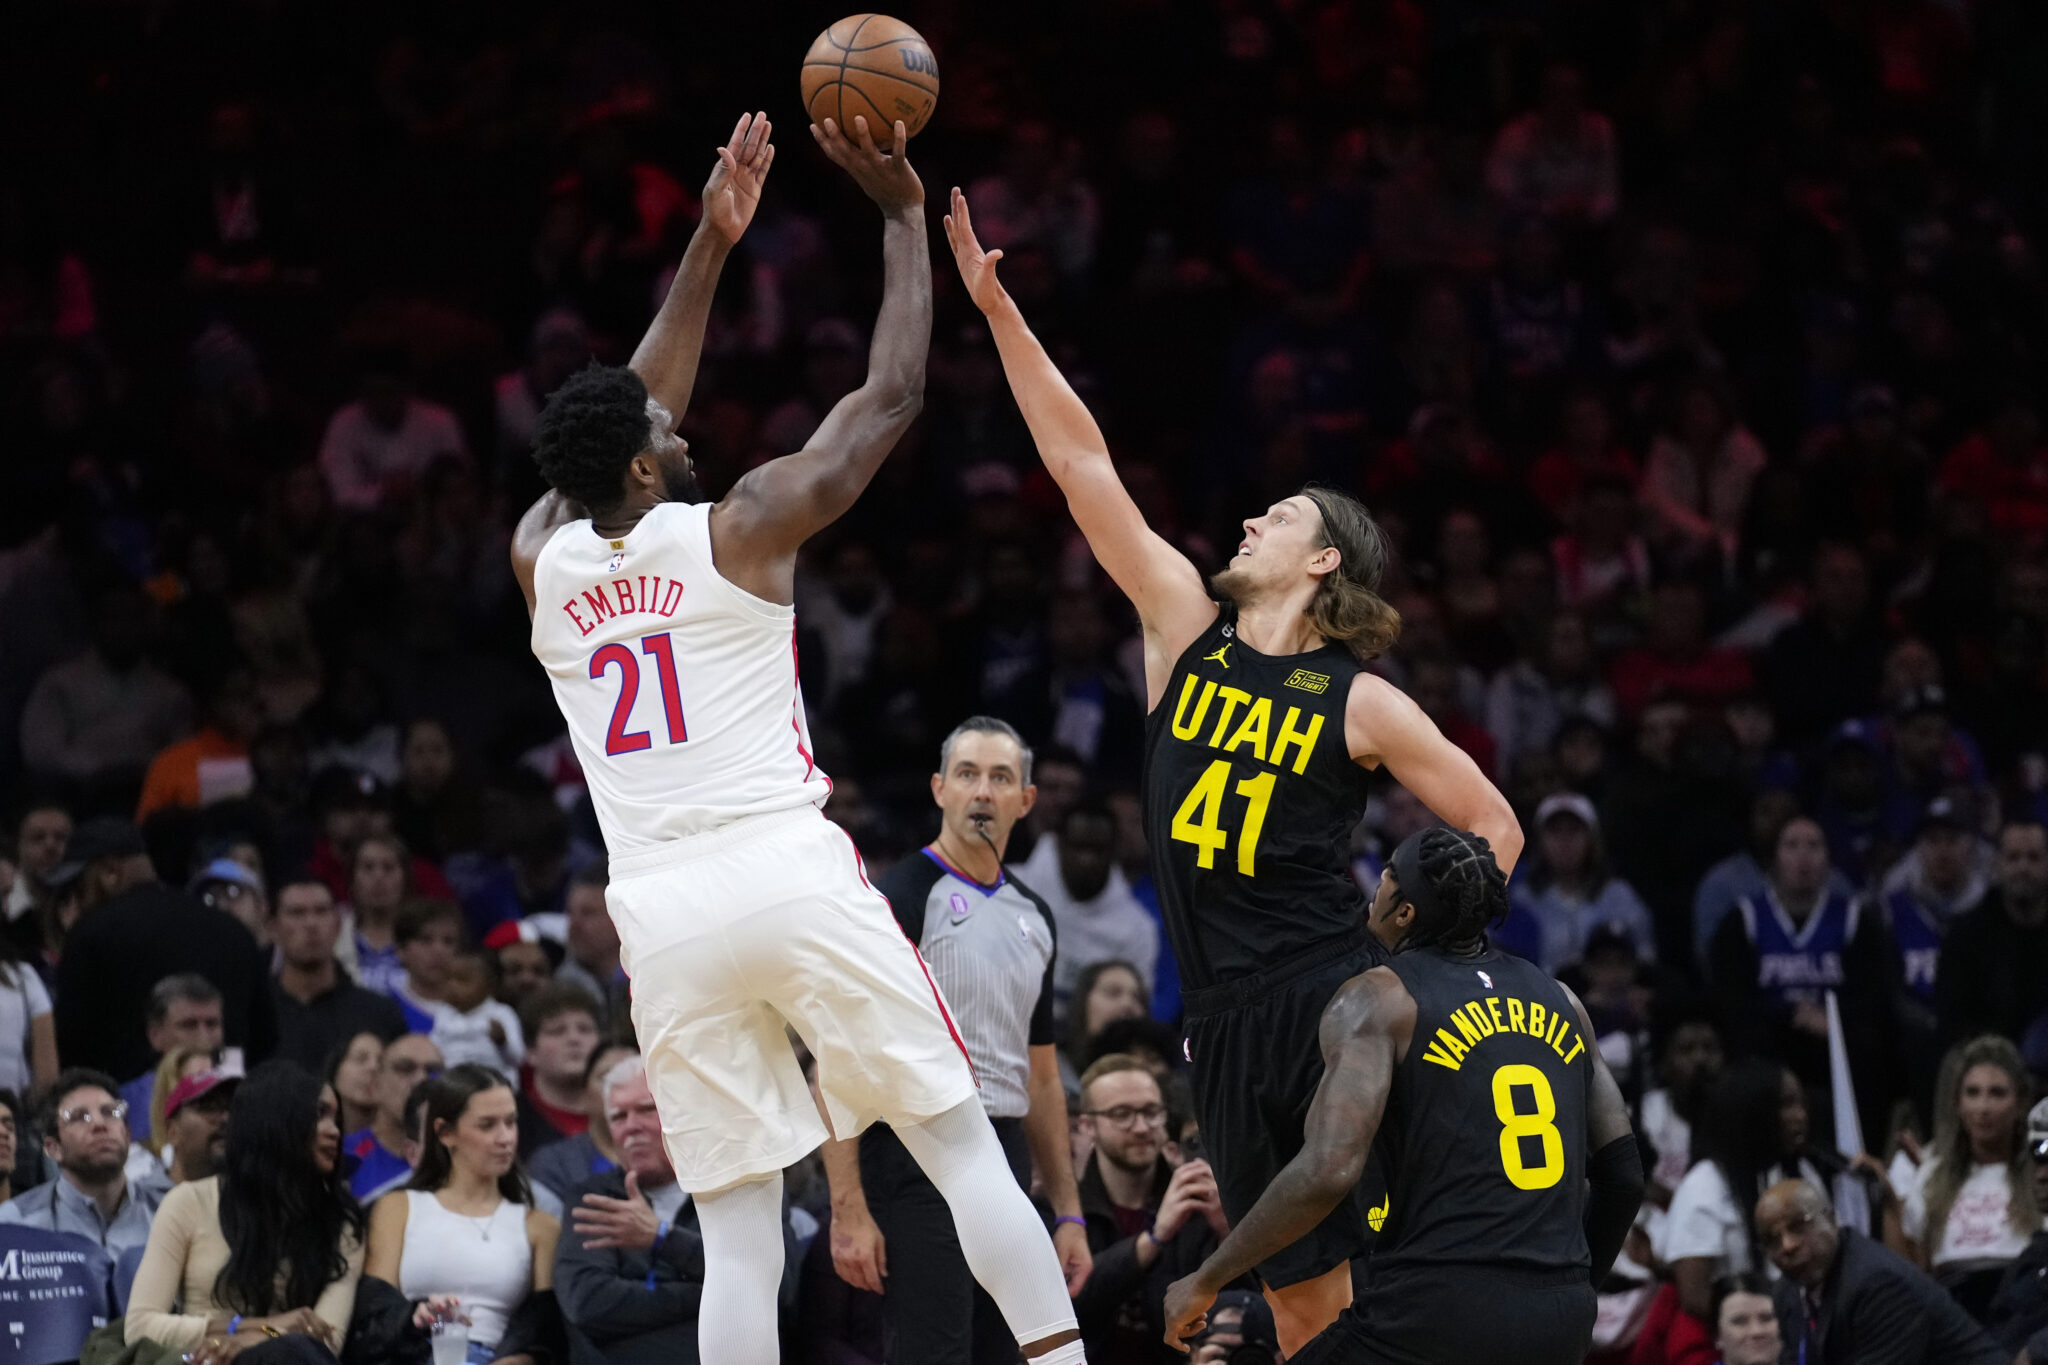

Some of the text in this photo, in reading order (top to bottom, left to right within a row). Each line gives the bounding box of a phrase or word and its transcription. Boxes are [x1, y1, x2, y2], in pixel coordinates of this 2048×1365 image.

[562, 576, 684, 636] EMBIID
[589, 632, 688, 757] 21
[1289, 672, 1305, 685] 5
[1300, 680, 1325, 692] FIGHT
[1171, 672, 1326, 776] UTAH
[1170, 759, 1277, 878] 41
[1422, 997, 1585, 1071] VANDERBILT
[1491, 1063, 1565, 1190] 8
[22, 1249, 86, 1265] Insurance
[22, 1265, 63, 1281] Group
